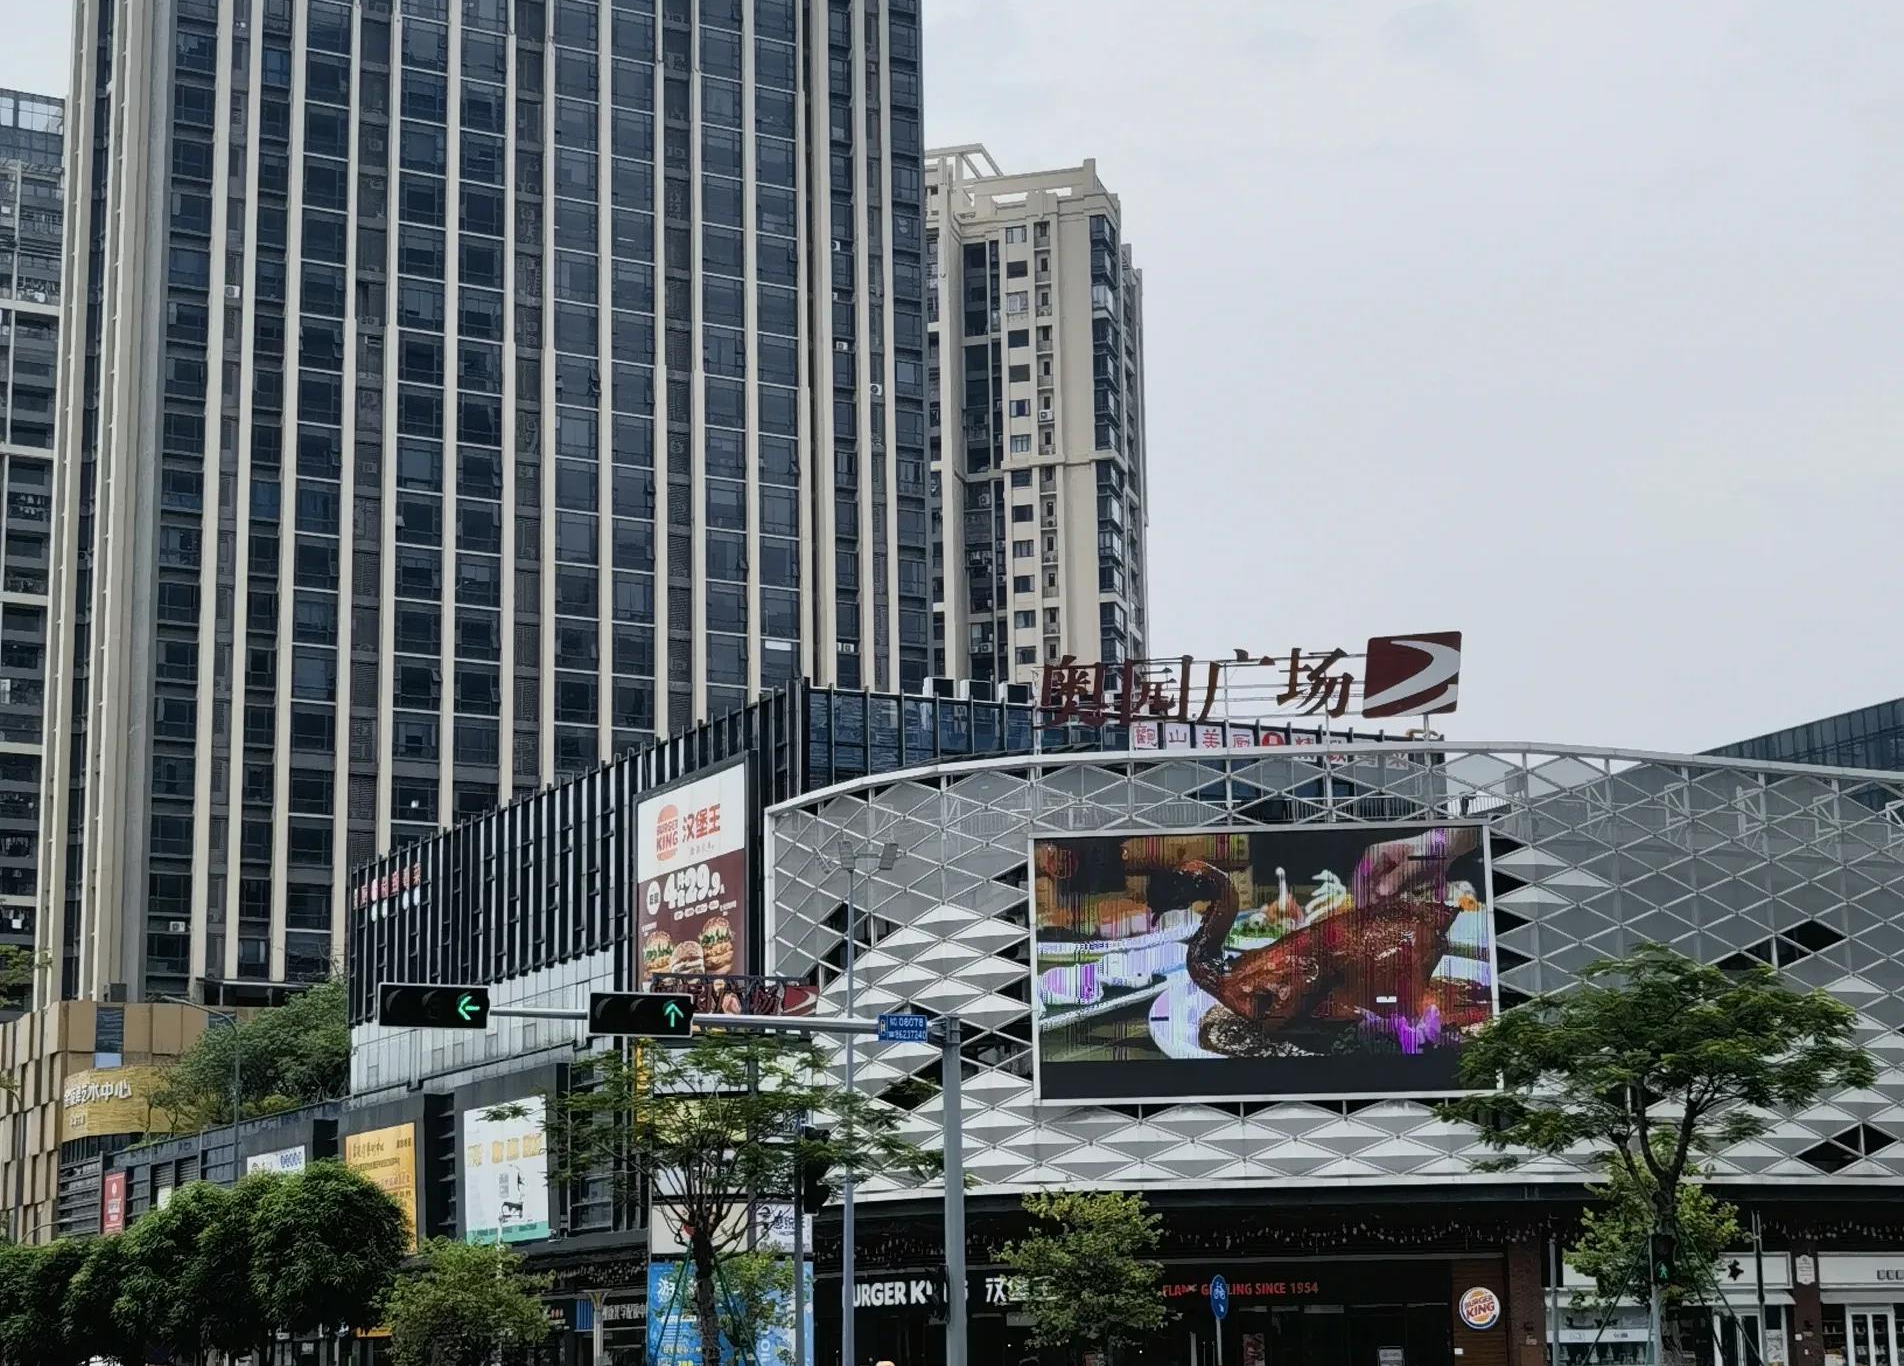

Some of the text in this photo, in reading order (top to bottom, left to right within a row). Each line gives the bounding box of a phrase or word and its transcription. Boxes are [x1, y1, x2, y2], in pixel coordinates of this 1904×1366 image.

[1042, 648, 1354, 725] 奥园广场
[682, 803, 720, 843] 汉堡王
[656, 831, 678, 852] KING
[843, 1280, 907, 1307] URGER
[1255, 1282, 1286, 1295] SINCE
[1290, 1281, 1319, 1294] 1954
[1466, 1301, 1495, 1319] KING
